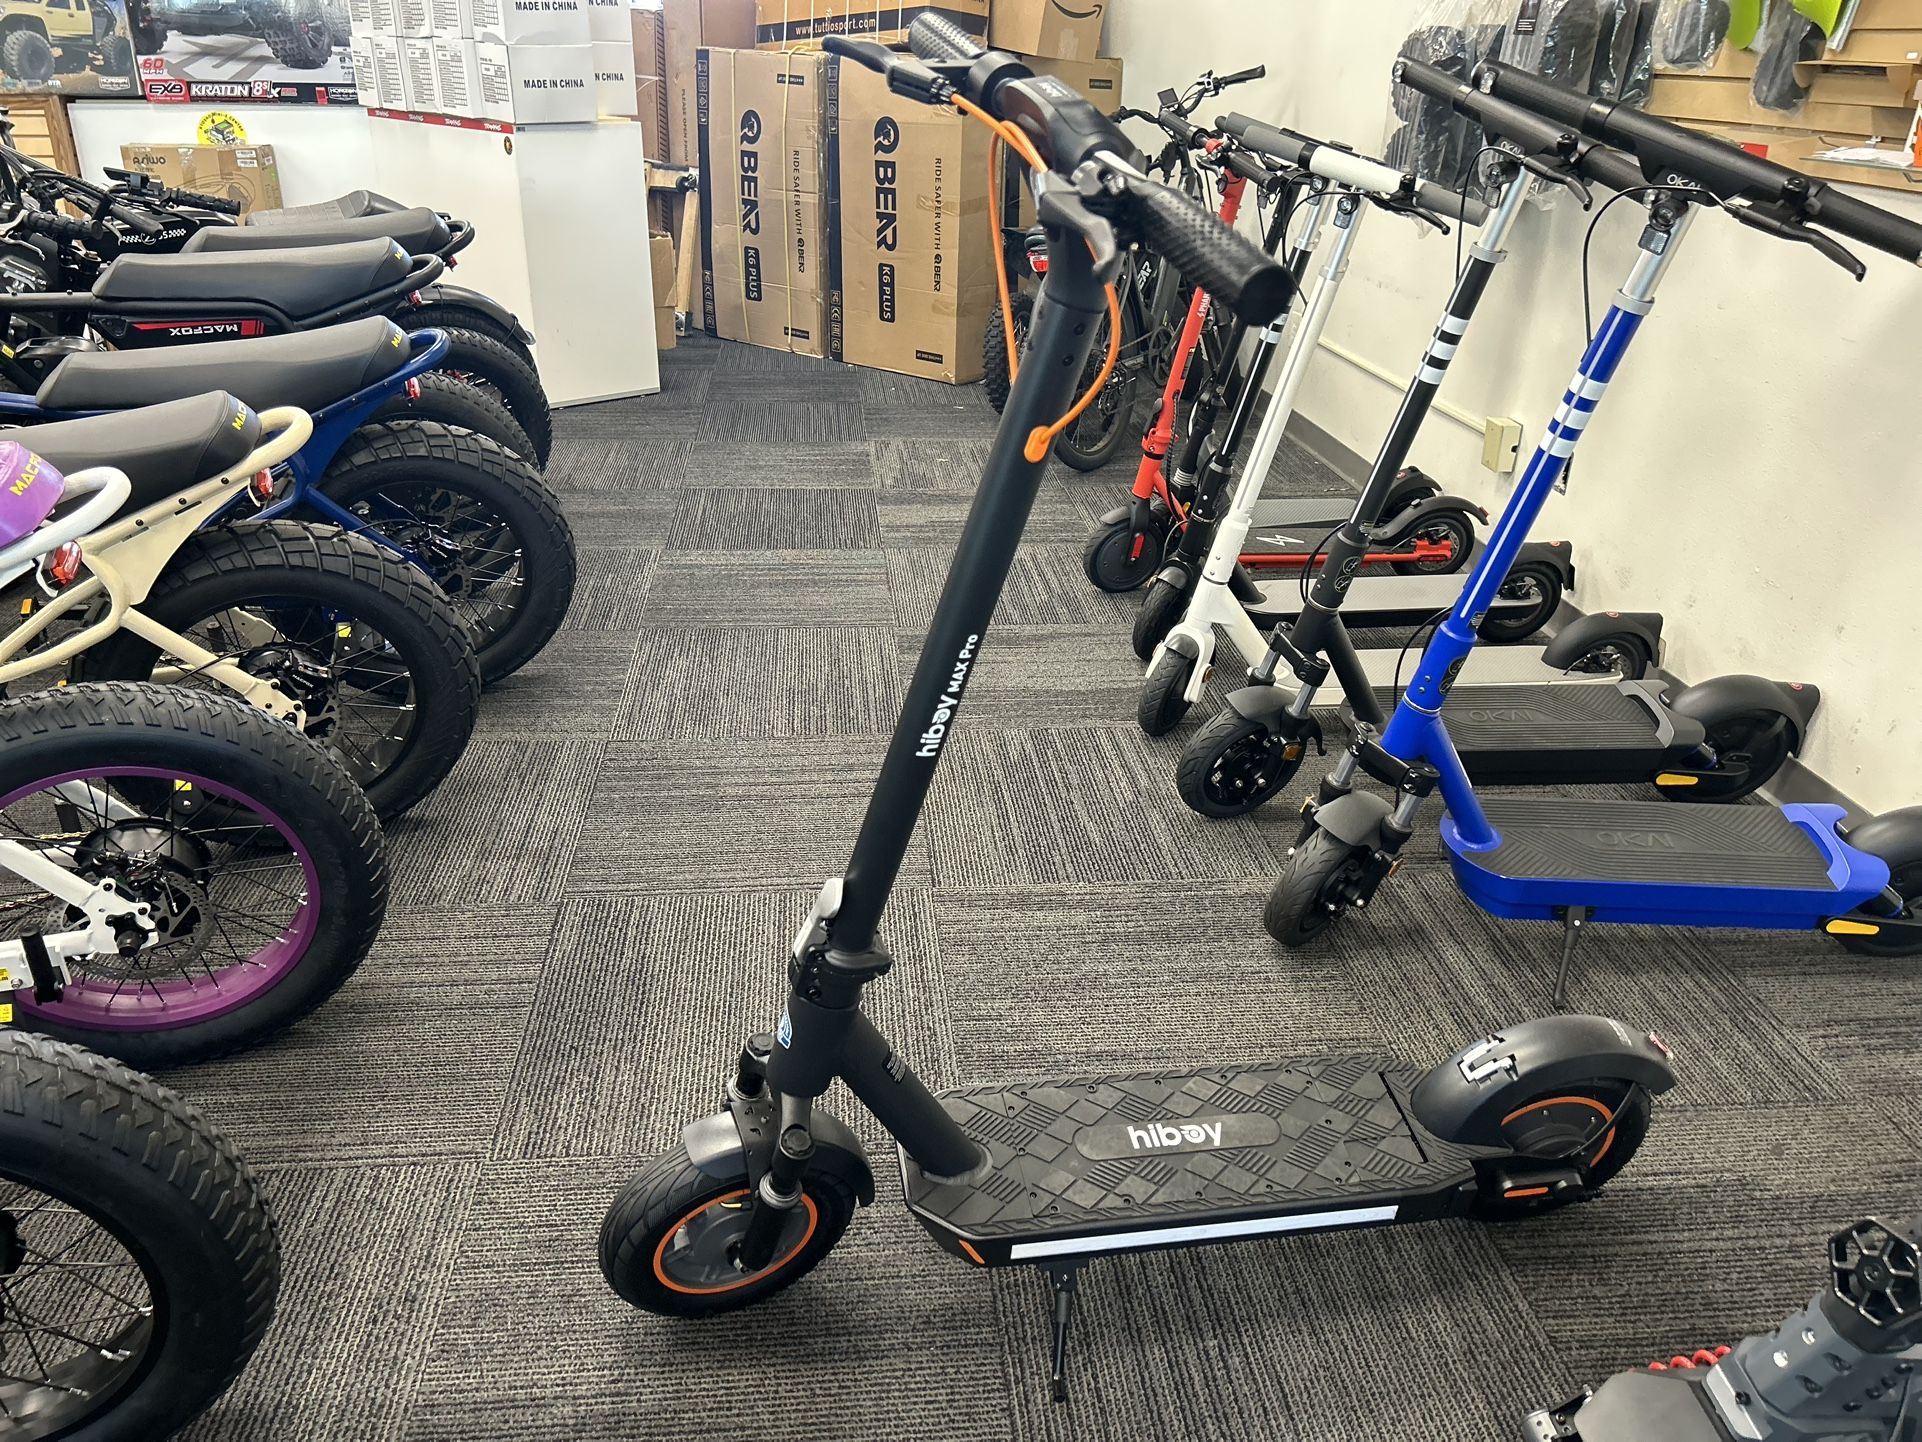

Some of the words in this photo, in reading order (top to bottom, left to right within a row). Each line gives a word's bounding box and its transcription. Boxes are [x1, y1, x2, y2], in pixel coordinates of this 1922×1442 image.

[515, 1, 542, 11] MADE
[542, 1, 551, 11] IN
[552, 1, 578, 11] CHINA
[143, 57, 164, 69] 60
[523, 79, 548, 89] MADE
[549, 79, 558, 89] IN
[559, 79, 585, 88] CHINA
[601, 72, 625, 81] CHINA
[190, 83, 250, 97] KRATON
[934, 157, 942, 181] RIDE
[793, 175, 801, 207] SAFER
[934, 183, 942, 214] SAFER
[794, 209, 802, 235] WITH
[934, 216, 942, 250] WITH
[748, 250, 758, 266] K6
[882, 266, 891, 283] K6
[749, 268, 759, 299] PLUS
[882, 286, 891, 319] PLUS
[169, 323, 239, 337] MACFOX
[915, 694, 958, 757] hiboy
[946, 661, 969, 692] MAX
[958, 634, 979, 659] Pro
[1469, 709, 1534, 721] OKAI
[1595, 831, 1675, 848] OKAI
[1126, 1122, 1222, 1150] hiboy
